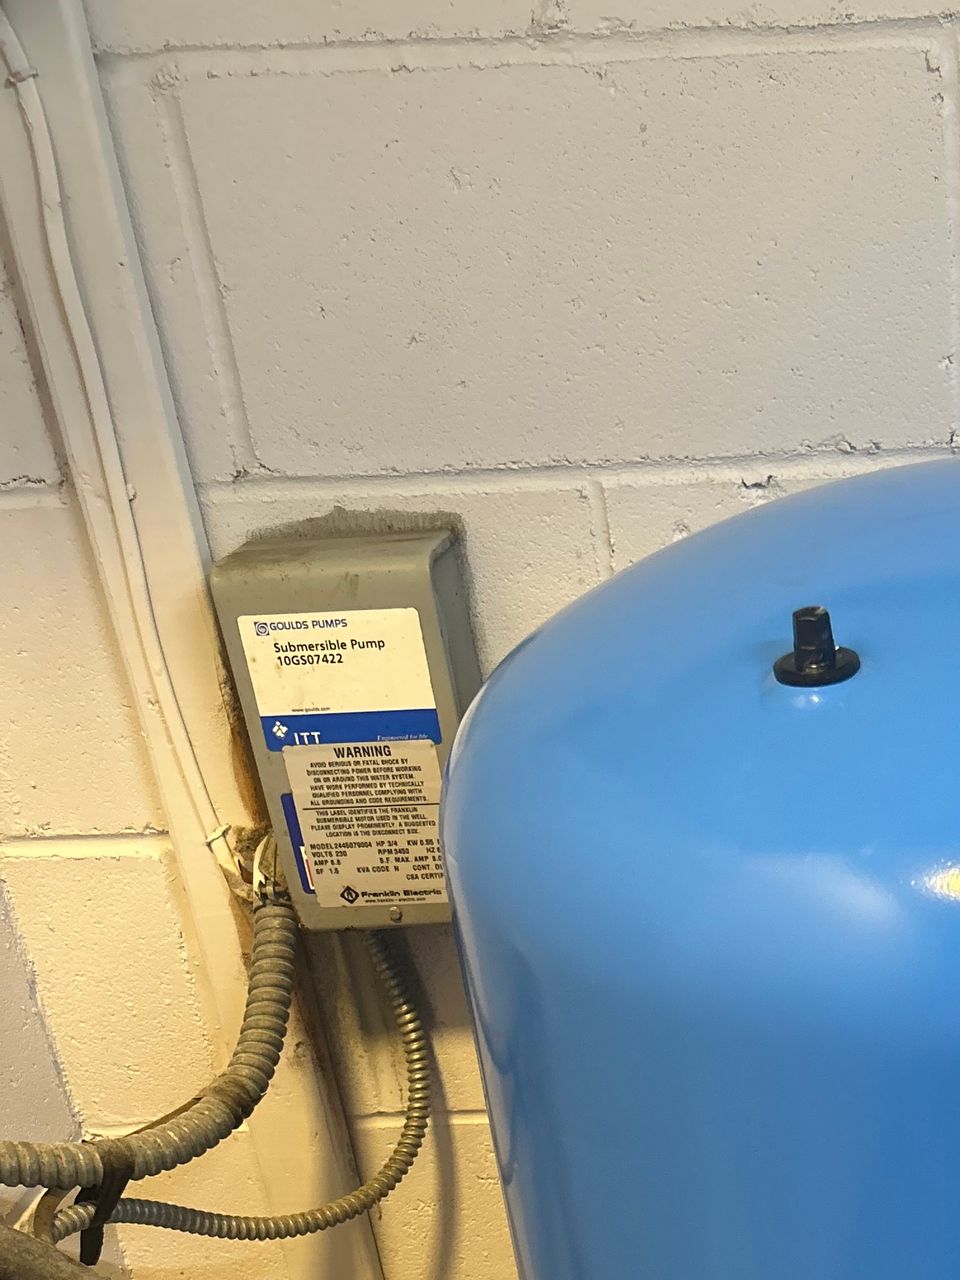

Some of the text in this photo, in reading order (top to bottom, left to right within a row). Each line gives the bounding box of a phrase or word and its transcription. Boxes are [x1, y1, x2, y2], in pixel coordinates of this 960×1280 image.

[269, 618, 348, 632] GOULDS PUMPS
[274, 638, 386, 654] Submersible Pump
[276, 654, 344, 667] 10GS07422
[294, 732, 320, 745] ITT
[334, 745, 392, 758] WARNING
[361, 890, 400, 898] Franklin
